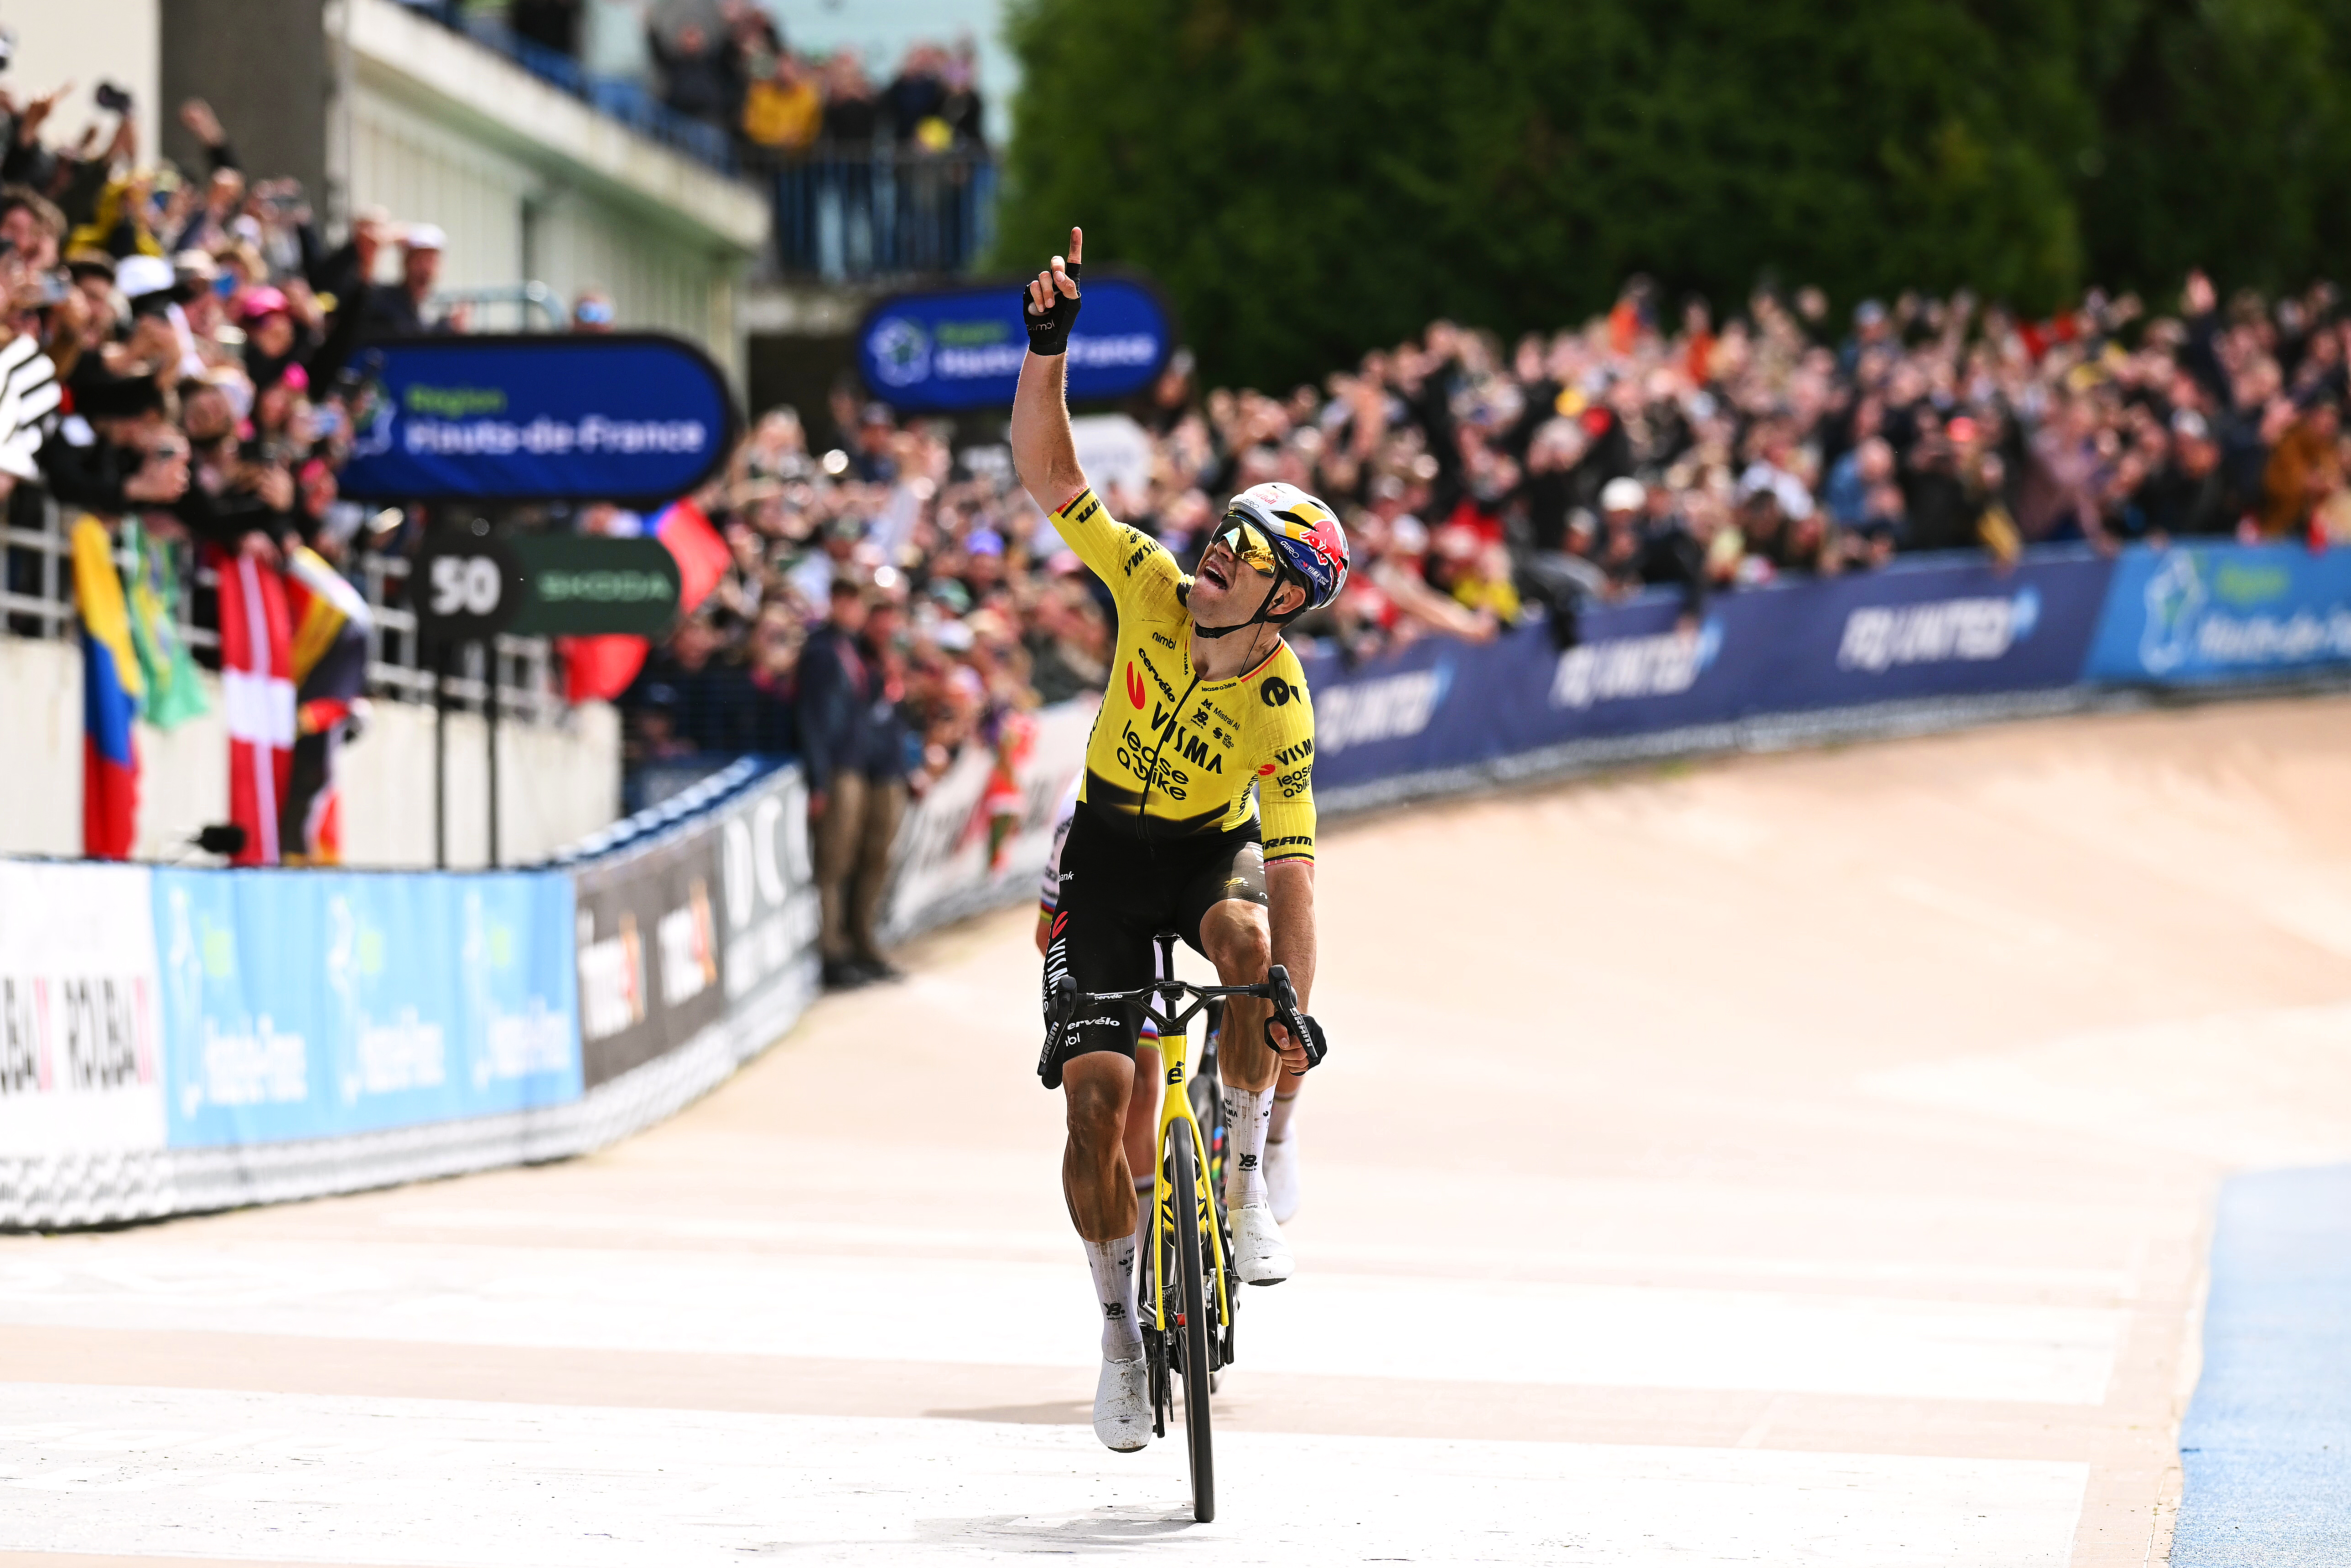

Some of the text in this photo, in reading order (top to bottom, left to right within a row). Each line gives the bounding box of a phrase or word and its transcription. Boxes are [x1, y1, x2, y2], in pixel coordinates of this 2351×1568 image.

[404, 416, 707, 454] Hauts-de-France
[1242, 498, 1259, 508] GIRO
[1280, 541, 1299, 558] GIRO
[1307, 565, 1320, 578] VISMA
[428, 554, 502, 616] 50
[1152, 632, 1177, 650] nimbl
[1138, 647, 1175, 703] cervélo
[1213, 707, 1240, 730] Mistral AI
[1151, 700, 1222, 774] VISMA
[1222, 740, 1230, 749] TEAM
[1224, 736, 1234, 748] WORLD
[1122, 719, 1189, 784] lease
[1275, 736, 1314, 766] VISM
[1277, 764, 1312, 787] lease
[1067, 1017, 1120, 1030] ervélo
[1289, 1007, 1313, 1047] SRAM
[1041, 1021, 1059, 1064] SRAM
[1126, 1246, 1135, 1254] nim
